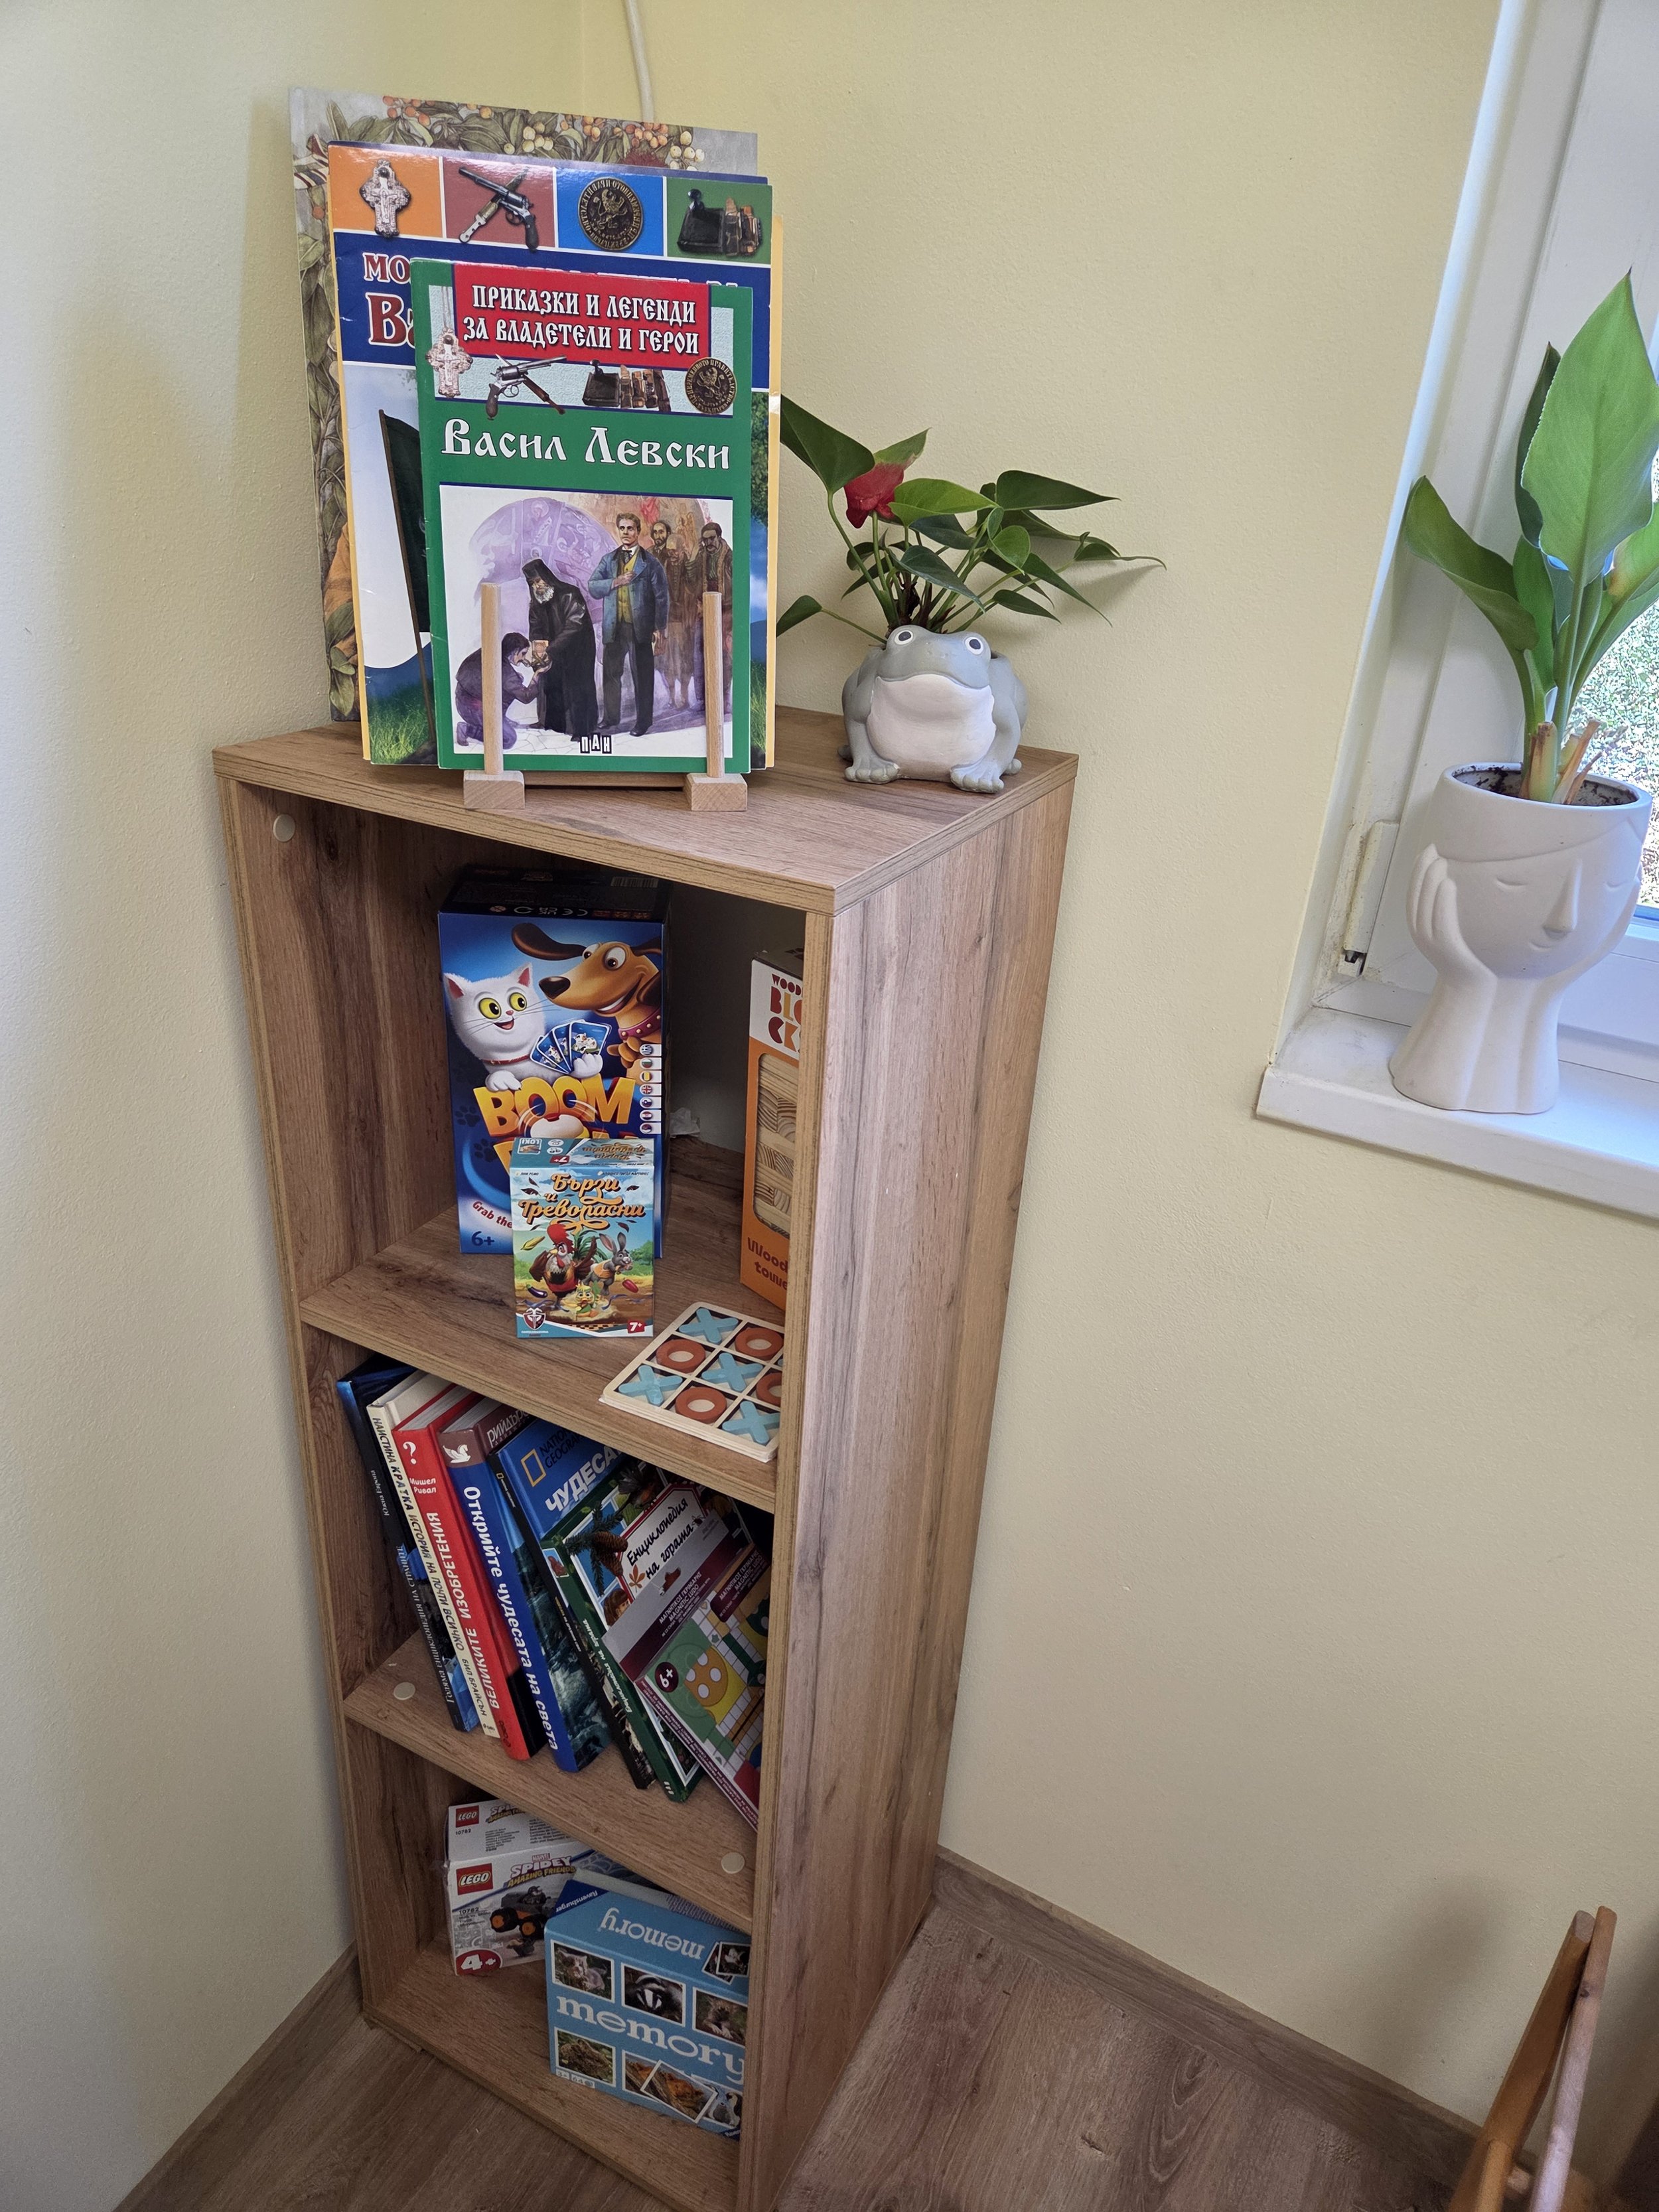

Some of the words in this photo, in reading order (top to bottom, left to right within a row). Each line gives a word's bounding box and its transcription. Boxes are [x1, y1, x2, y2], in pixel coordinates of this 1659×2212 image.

[472, 285, 579, 315] ПРИКАЗКИ
[586, 294, 600, 316] И
[607, 295, 695, 327] ЛЕГЕНДИ
[463, 317, 489, 340] ЗА
[496, 319, 612, 348] ВЛАДЕТЕЛИ
[618, 328, 632, 350] И
[638, 329, 699, 354] ГЕРОИ
[581, 734, 610, 752] ПАН
[772, 973, 803, 997] WOOD
[768, 1017, 800, 1054] CK
[472, 1073, 636, 1138] BOOM
[543, 1192, 558, 1202] и
[551, 1173, 623, 1205] Бързи
[472, 1201, 494, 1220] Grab
[496, 1216, 512, 1228] the
[518, 1199, 646, 1232] Тревопасни
[472, 1230, 495, 1246] 6+
[630, 1322, 643, 1331] 7+
[372, 1418, 397, 1463] НАИСТИНА
[391, 1465, 414, 1511] КРАТКА
[545, 1445, 622, 1512] ЧУДЕСА
[409, 1514, 432, 1560] ИСТОРИЯ
[627, 1498, 688, 1566] Енциклопедия
[426, 1562, 437, 1574] НА
[427, 1512, 472, 1619] ИЗОБРЕТЕНИЯ
[646, 1562, 660, 1580] на
[660, 1524, 693, 1562] гората
[431, 1577, 449, 1606] ПОЧТИ
[668, 1598, 689, 1621] MAGNETIC
[687, 1584, 699, 1600] LUDO
[443, 1608, 465, 1651] ВСИЧКО
[464, 1487, 503, 1577] Открийте
[496, 1585, 532, 1668] чудесата
[529, 1672, 541, 1696] на
[535, 1699, 559, 1750] света
[466, 1628, 500, 1709] ВЕЛИКИТЕ
[659, 1668, 674, 1688] 6+
[462, 1659, 472, 1675] БИЛ
[469, 1677, 487, 1716] БРАЙСЪН
[457, 1811, 477, 1821] LEGO
[459, 1872, 491, 1887] LEGO
[507, 1870, 543, 1888] AMAZING
[544, 1866, 577, 1879] FRIENDS
[510, 1856, 572, 1878] SPIDEY
[555, 1890, 598, 1913] Ravensburger
[600, 1907, 705, 1960] memory
[461, 1953, 496, 1970] 4+
[557, 1996, 745, 2085] memory
